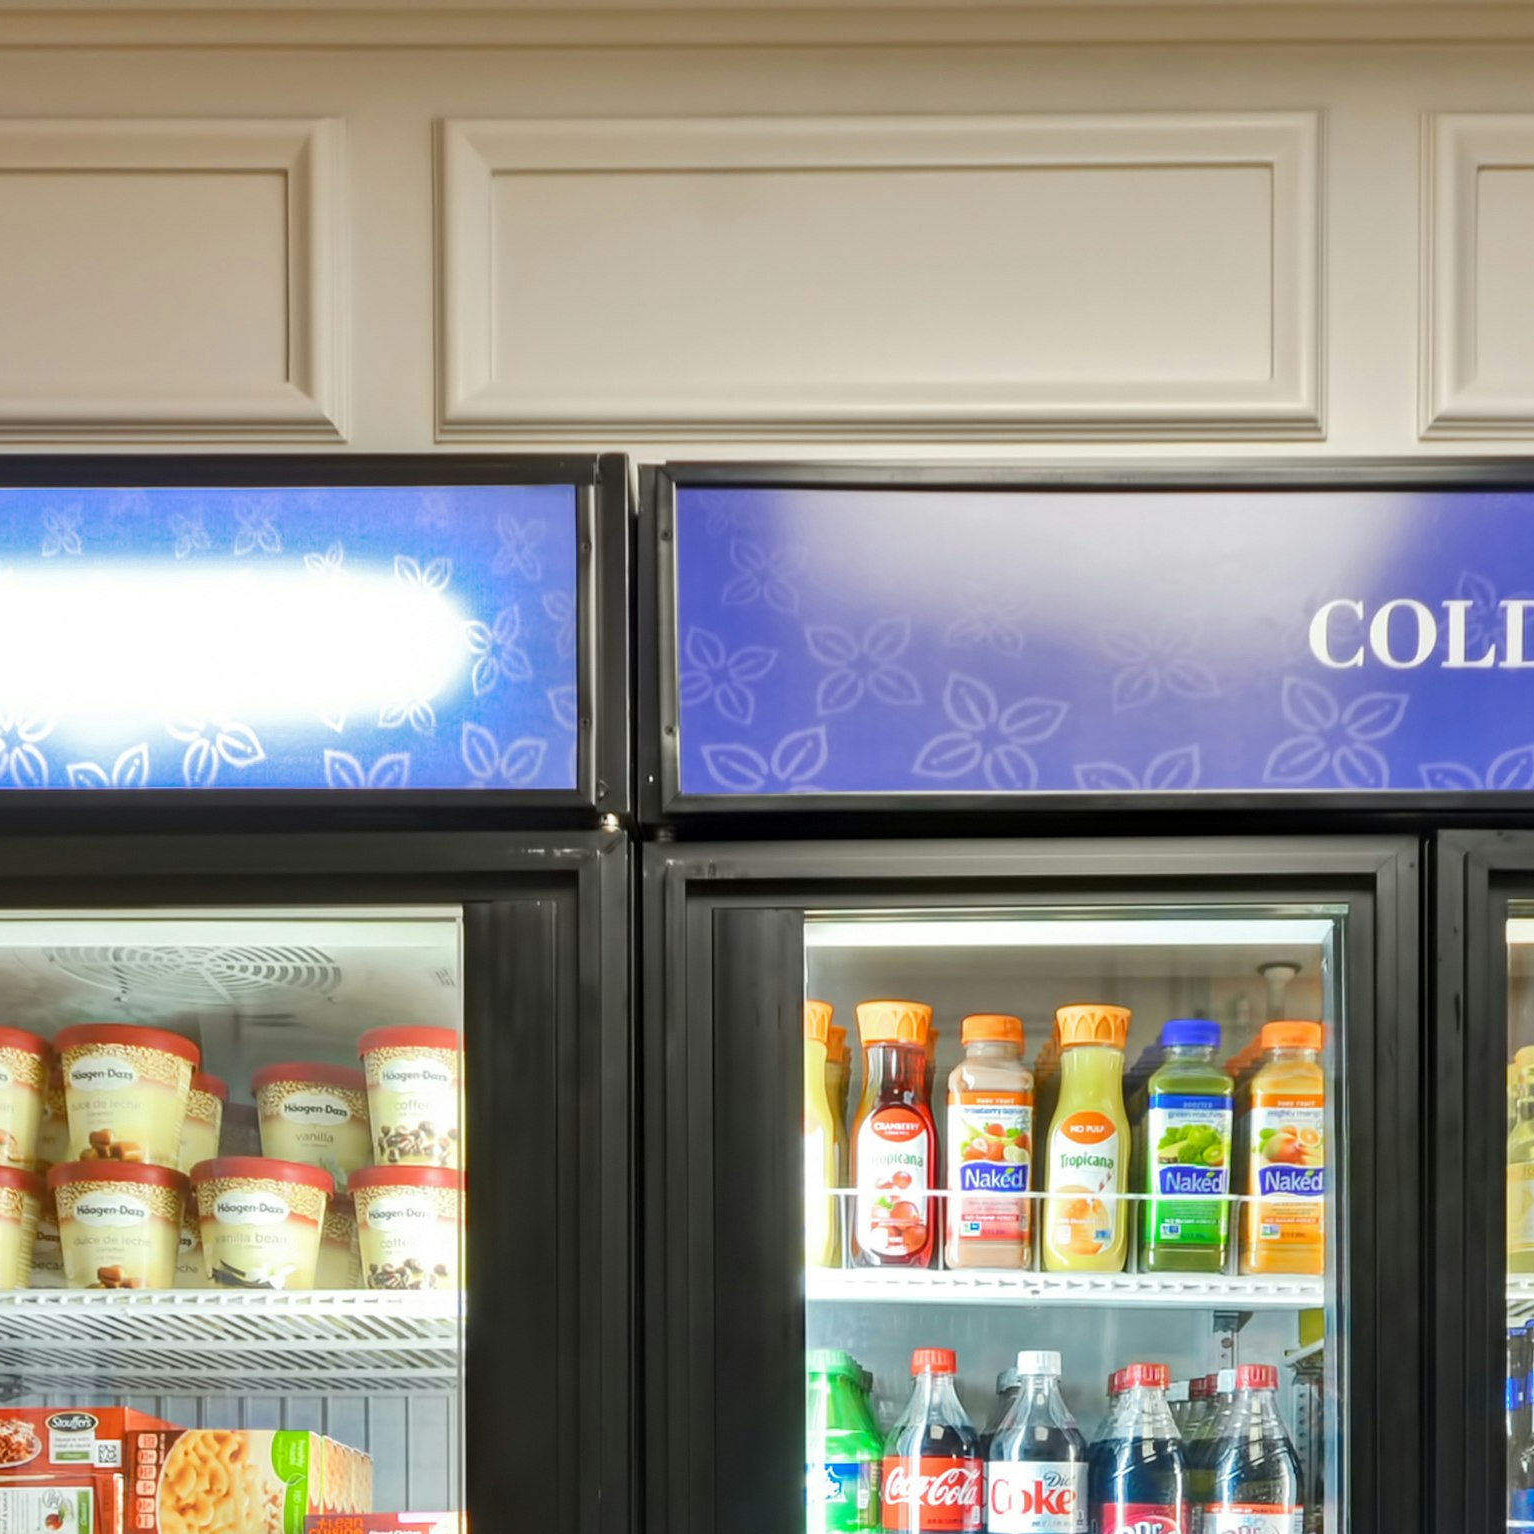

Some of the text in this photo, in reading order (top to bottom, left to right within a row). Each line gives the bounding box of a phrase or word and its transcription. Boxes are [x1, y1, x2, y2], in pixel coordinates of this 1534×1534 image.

[295, 1131, 334, 1144] vanilla
[1070, 1125, 1105, 1134] NO PULP
[1060, 1153, 1114, 1169] Tropicana
[965, 1167, 1025, 1189] Naked
[1165, 1171, 1224, 1194] Naked
[1265, 1170, 1323, 1192] Naked
[215, 1232, 251, 1244] vanilla
[885, 1466, 981, 1506] Coca-Cola
